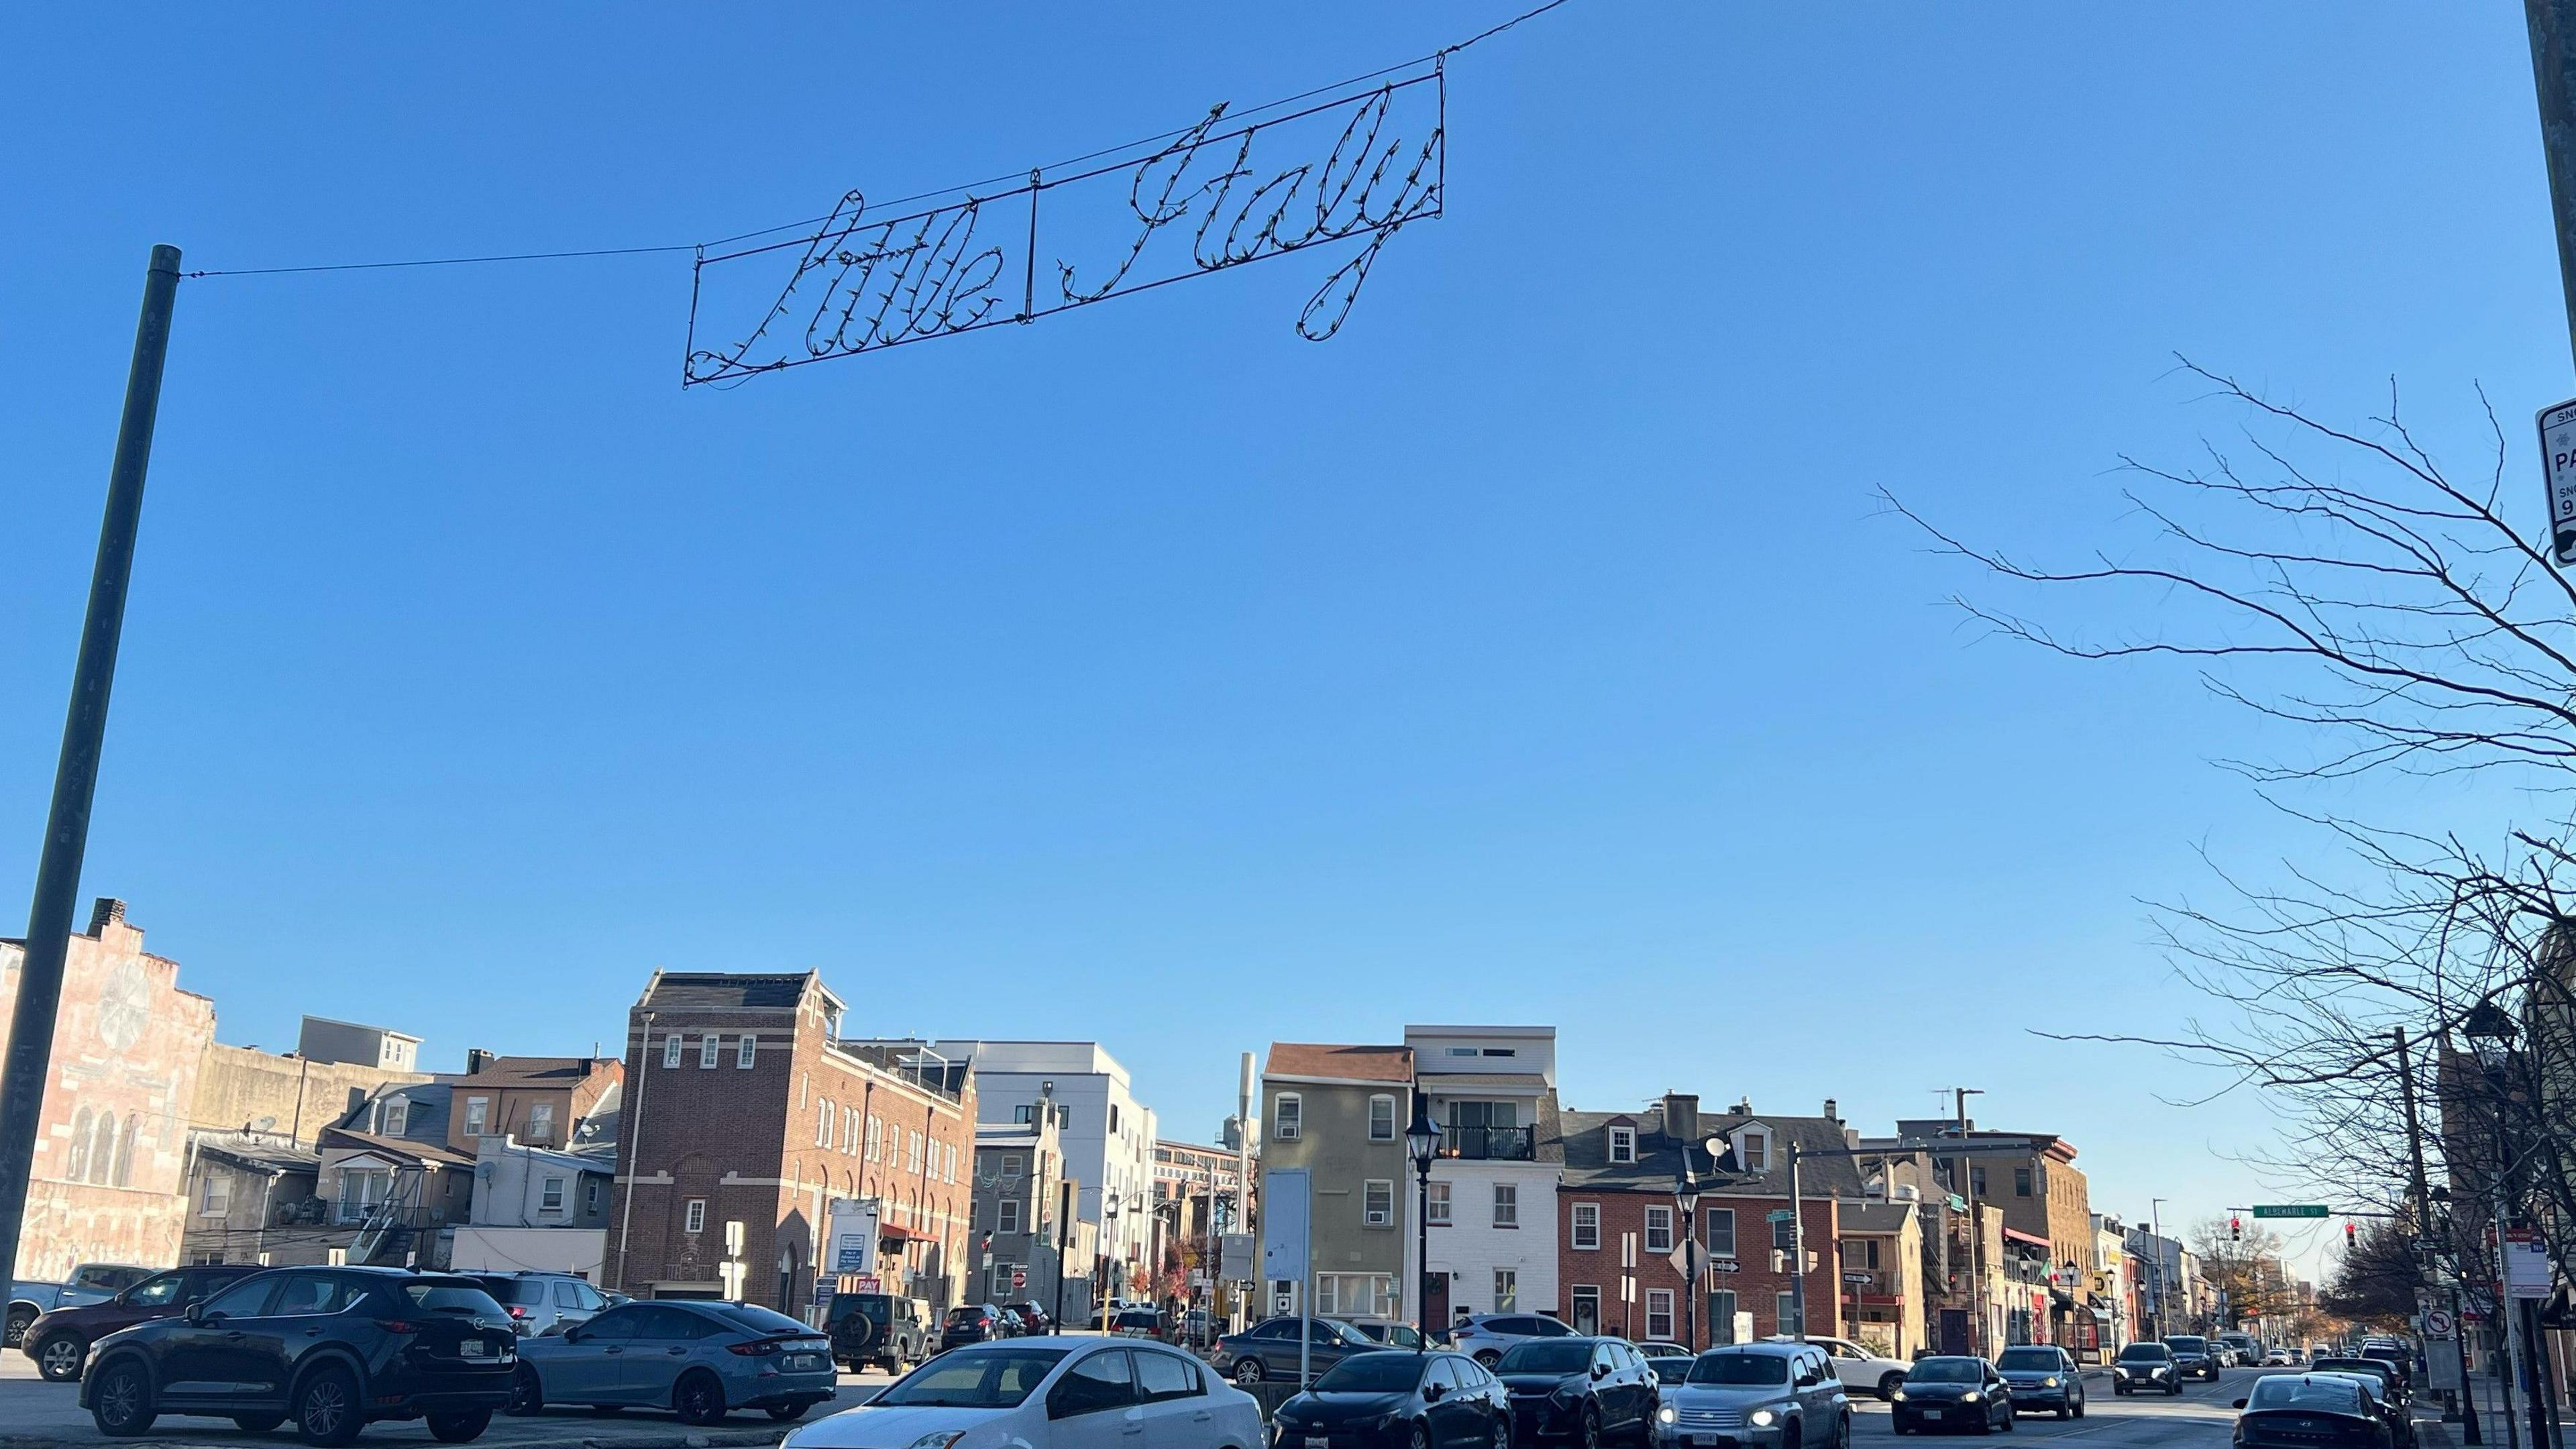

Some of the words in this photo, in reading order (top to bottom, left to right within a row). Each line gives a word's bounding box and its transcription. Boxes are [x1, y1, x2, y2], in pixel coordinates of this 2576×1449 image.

[684, 187, 1005, 384] Little
[1056, 87, 1444, 342] Italy
[2561, 499, 2574, 516] 9
[859, 1280, 879, 1290] PAY
